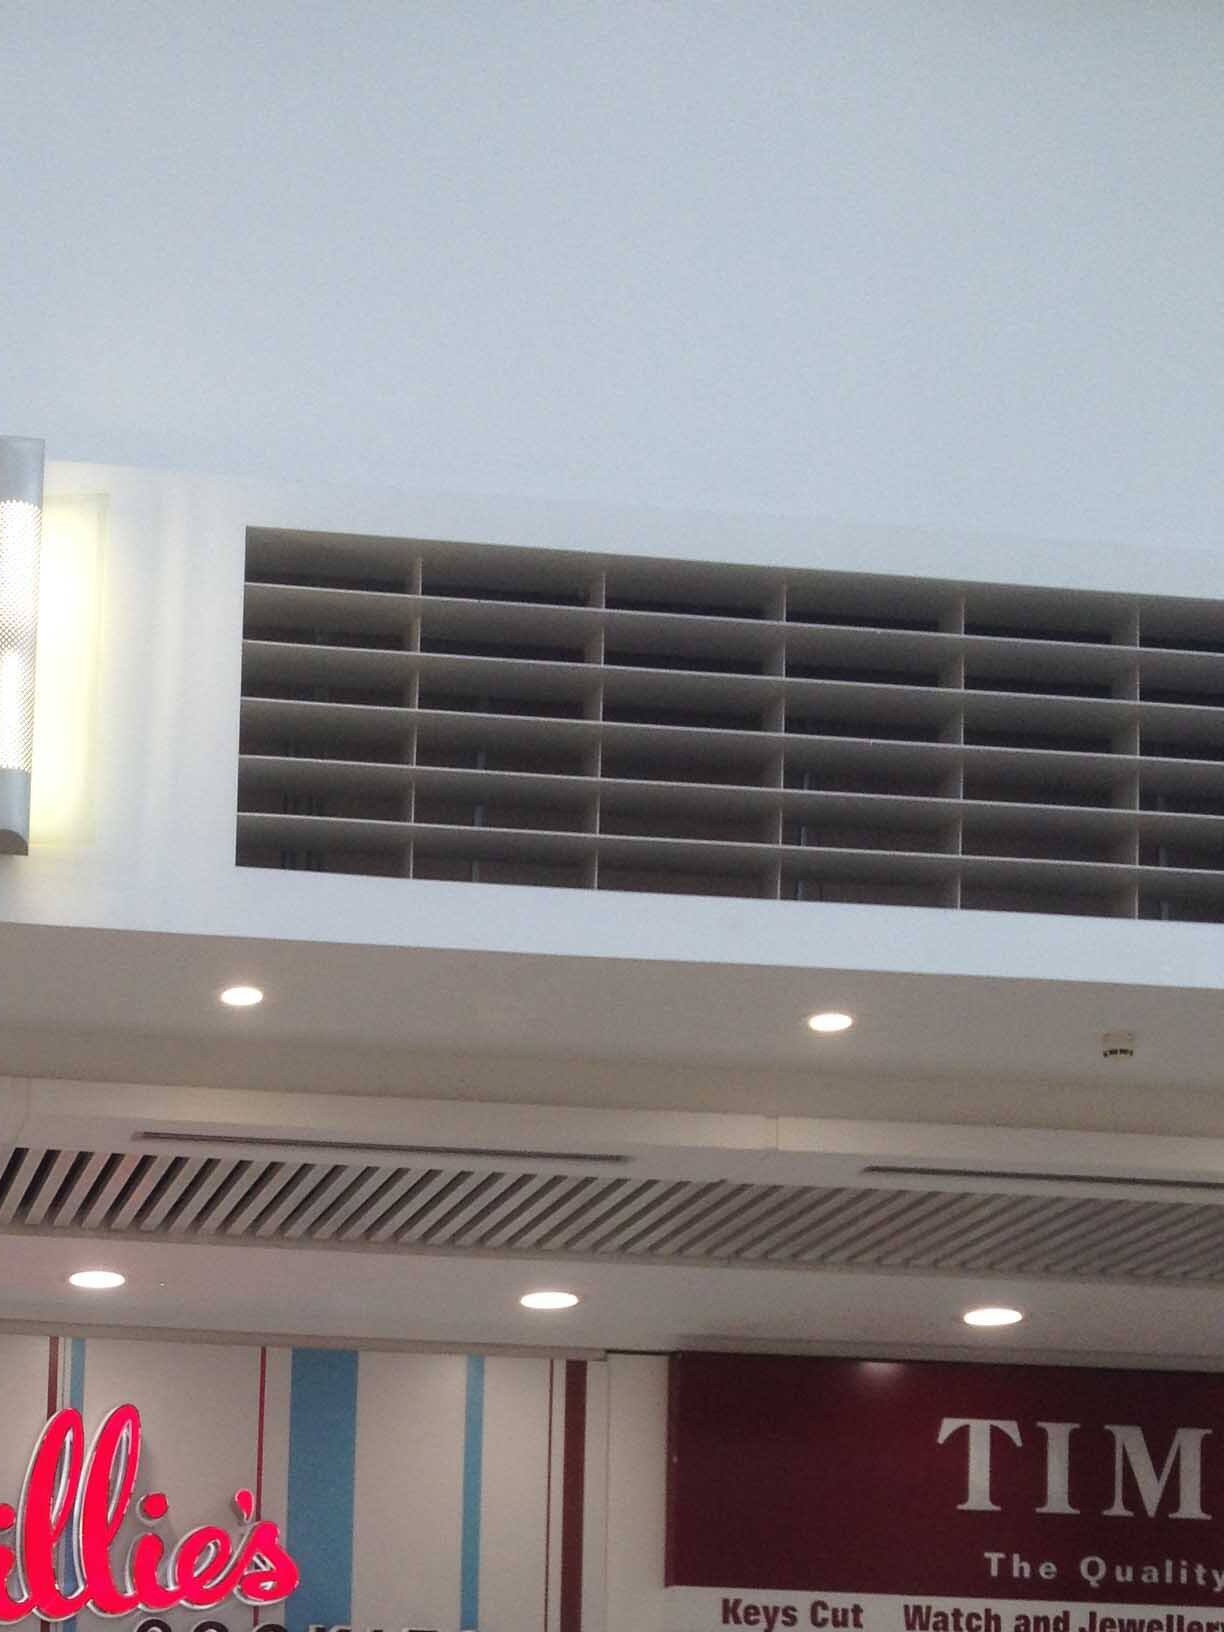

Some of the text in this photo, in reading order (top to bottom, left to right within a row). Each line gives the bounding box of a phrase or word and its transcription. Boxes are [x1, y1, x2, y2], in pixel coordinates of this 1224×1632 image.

[936, 1418, 1213, 1521] TIM
[984, 1552, 1224, 1592] The Quality
[722, 1599, 797, 1632] Keys
[810, 1600, 863, 1629] Cut
